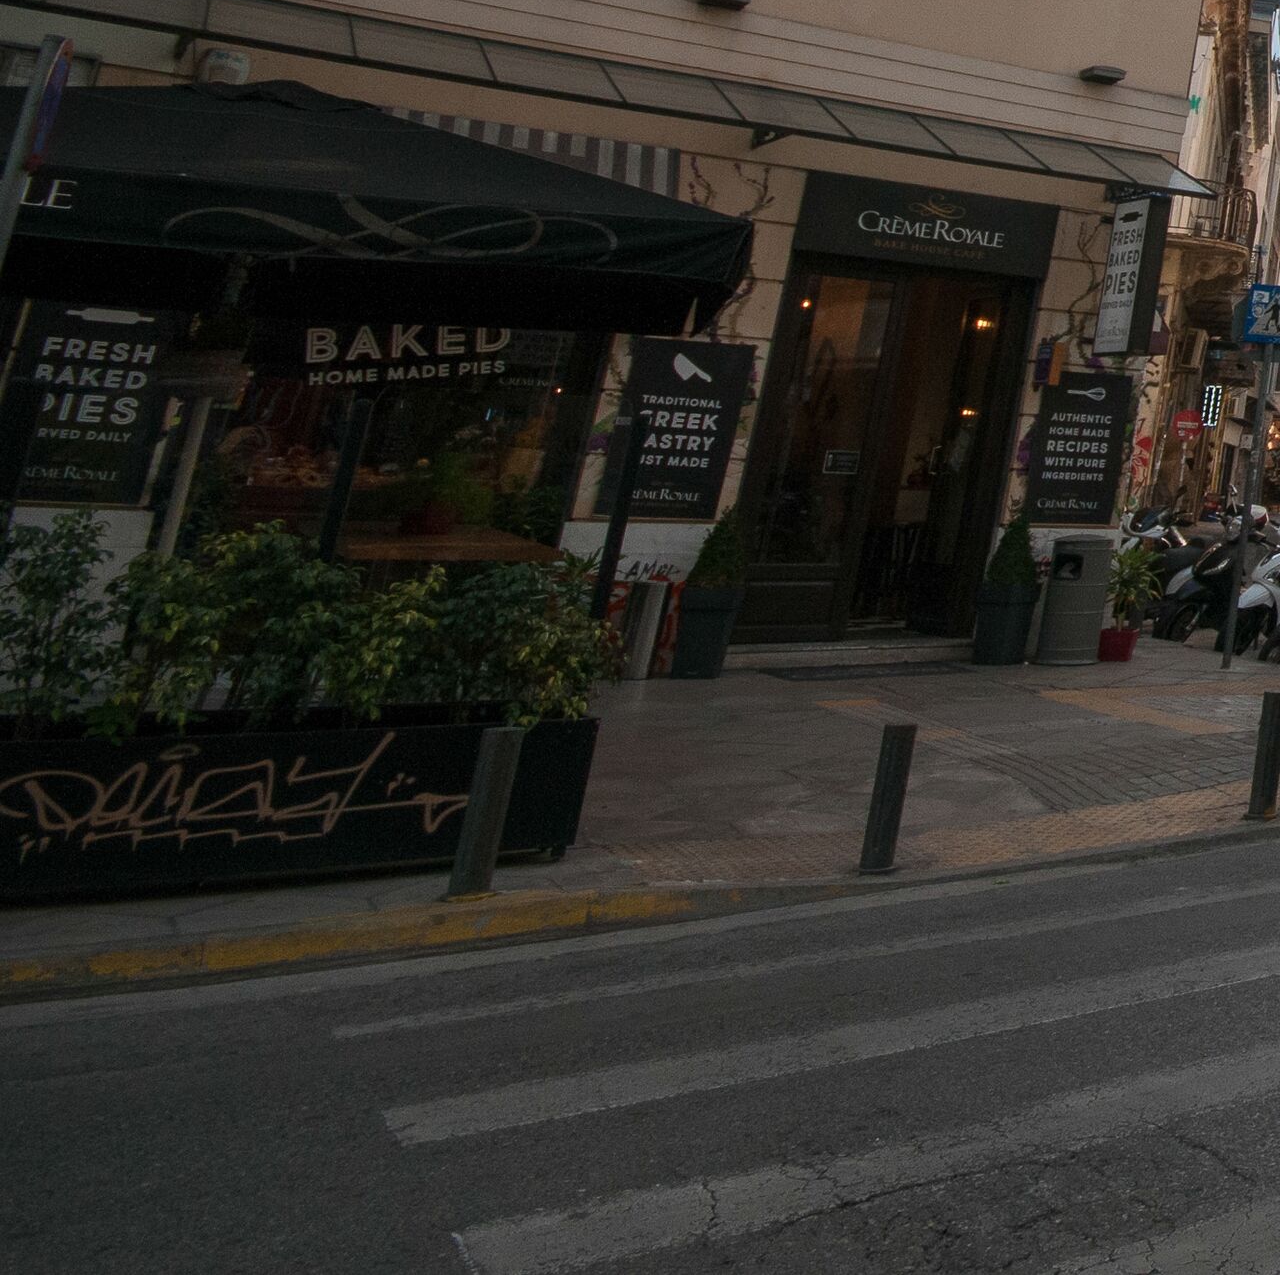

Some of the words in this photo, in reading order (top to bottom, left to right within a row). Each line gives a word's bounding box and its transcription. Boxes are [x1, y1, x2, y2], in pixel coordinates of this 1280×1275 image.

[1112, 228, 1144, 247] FRESH
[1108, 250, 1140, 268] BAKED
[1104, 271, 1136, 296] PIES
[41, 336, 156, 364] FRESH
[304, 324, 511, 364] BAKED
[35, 363, 148, 390] BAKED
[308, 368, 378, 386] HOME
[387, 363, 450, 380] MADE
[459, 359, 506, 376] PIES
[642, 394, 722, 409] TRADITIONAL
[1051, 412, 1112, 424] AUTHENTIC
[37, 427, 81, 441] RVED
[87, 429, 132, 443] DAILY
[1049, 426, 1079, 436] HOME
[1082, 427, 1110, 438] MADE
[644, 433, 715, 452] ASTRY
[1046, 440, 1108, 454] RECIPES
[667, 455, 710, 468] MADE
[1044, 456, 1074, 468] WITH
[1077, 458, 1107, 469] PURE
[1041, 471, 1104, 482] INGREDIENTS
